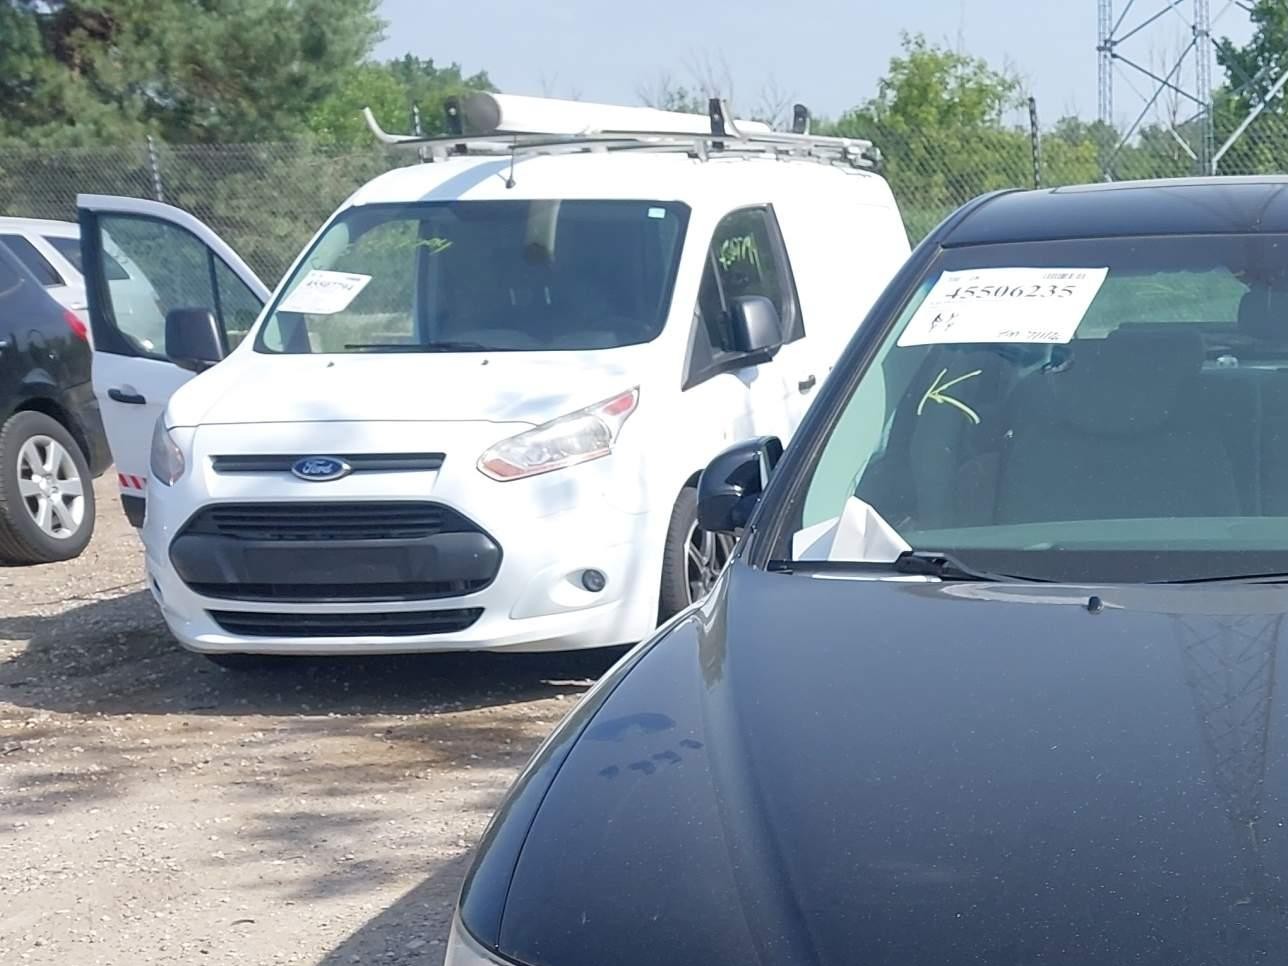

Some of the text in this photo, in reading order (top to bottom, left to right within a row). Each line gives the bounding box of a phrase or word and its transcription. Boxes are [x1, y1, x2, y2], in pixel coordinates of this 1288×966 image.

[945, 284, 1077, 300] 45506235
[917, 368, 983, 424] K
[302, 460, 334, 475] Ford
